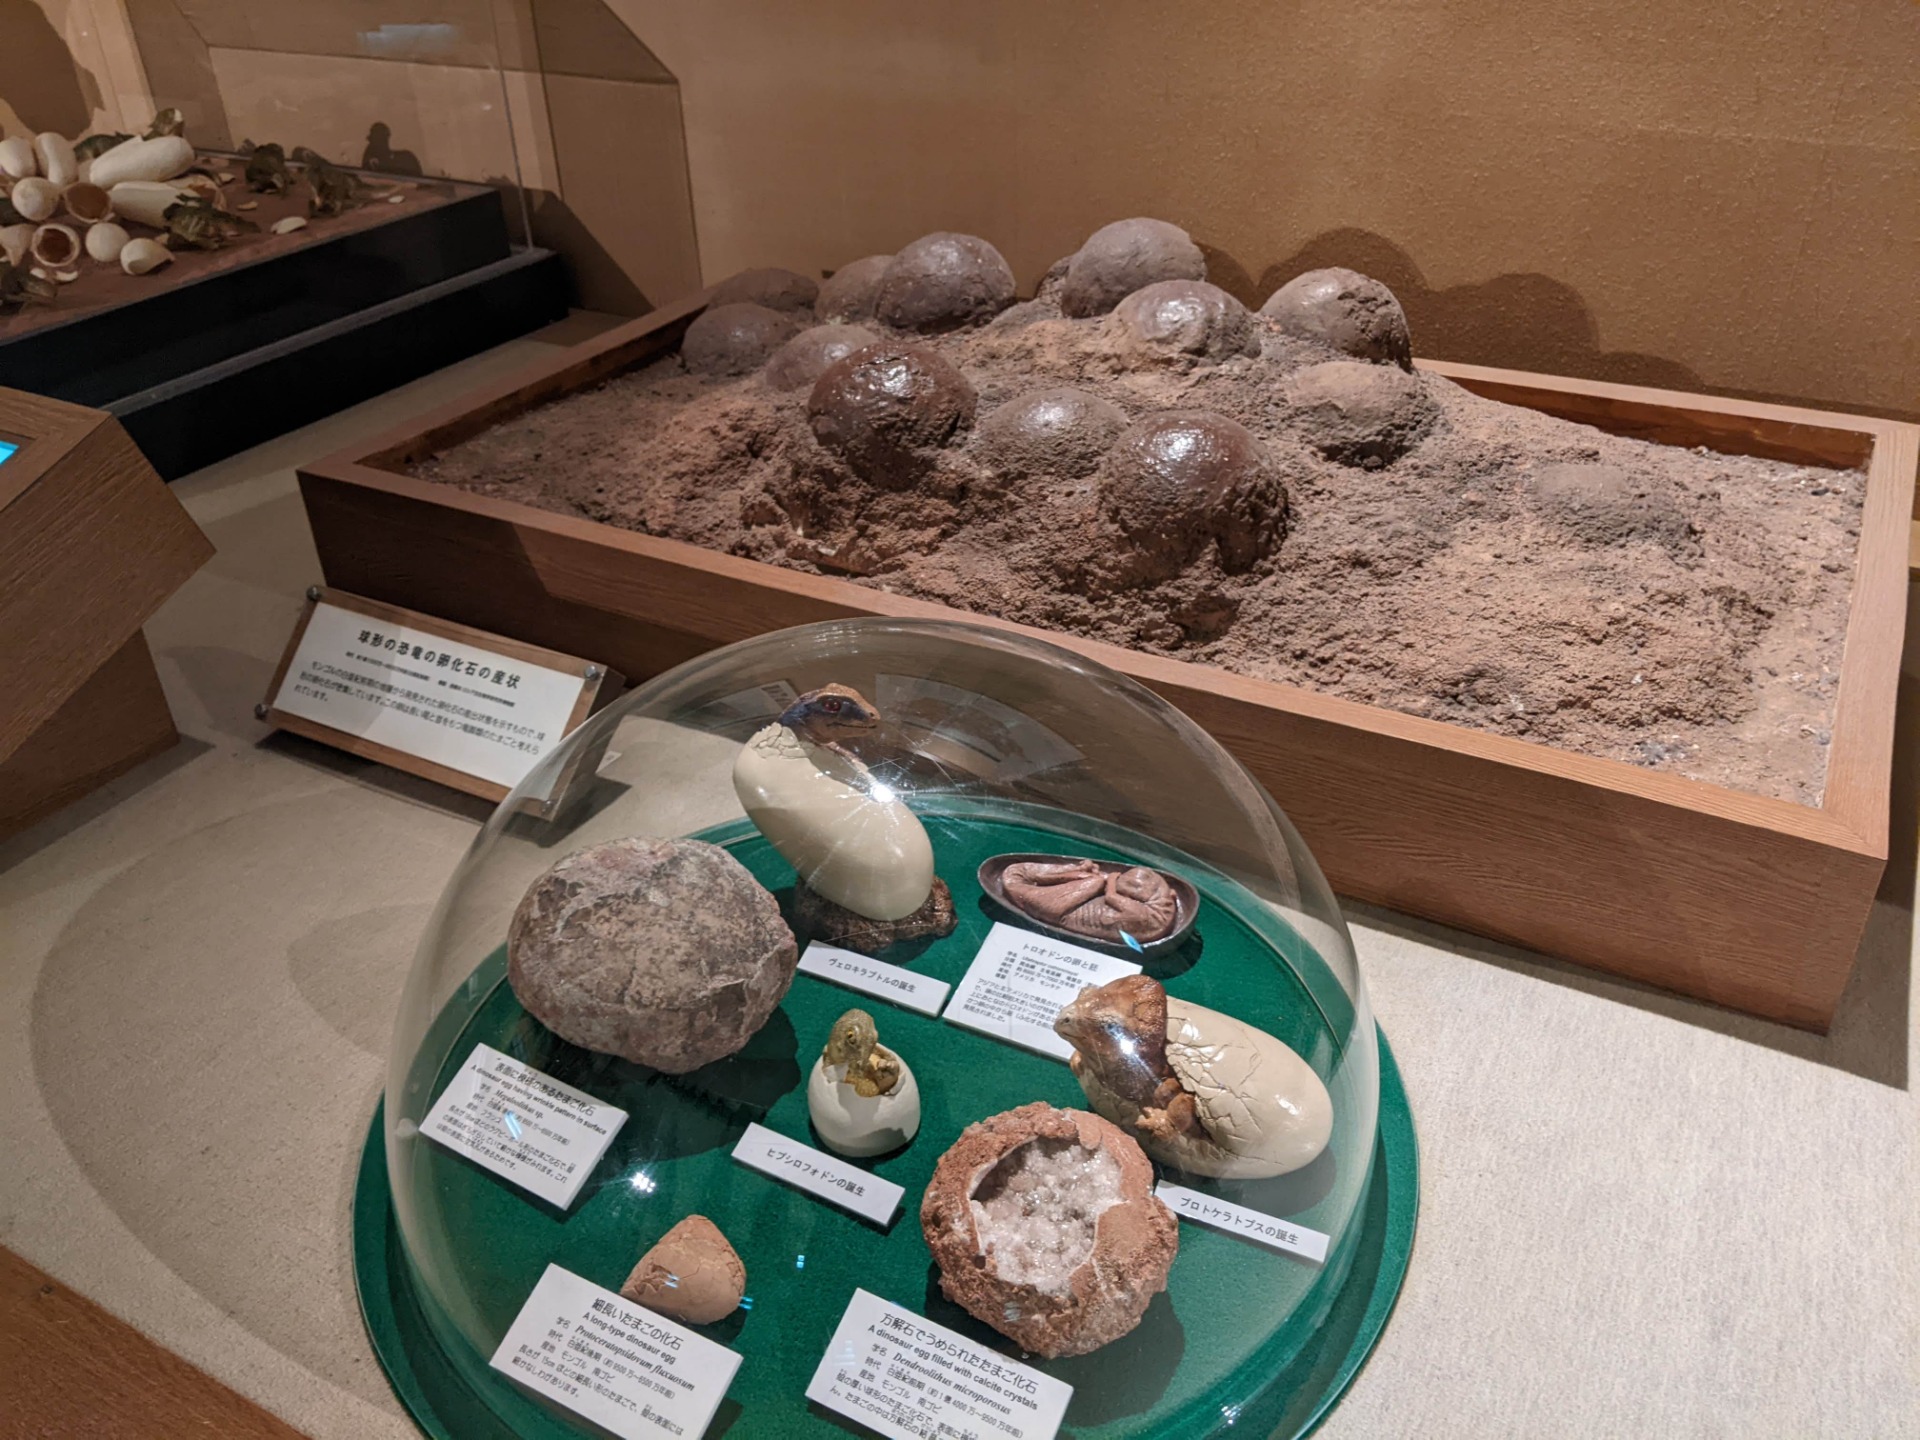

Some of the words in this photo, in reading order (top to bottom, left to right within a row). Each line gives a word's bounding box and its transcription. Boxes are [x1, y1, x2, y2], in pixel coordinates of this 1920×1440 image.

[357, 629, 521, 689] 球形の恐竜の卵化石の産状
[828, 957, 916, 993] ヴェロキラプトルの誕生
[1022, 943, 1099, 972] トロオドンの卵と胚
[475, 1067, 502, 1083] dinosaur
[500, 1080, 513, 1090] egg
[512, 1084, 533, 1100] having
[532, 1095, 555, 1109] wrinkle
[553, 1106, 576, 1121] pattern
[575, 1116, 584, 1124] in
[582, 1120, 607, 1135] surface
[766, 1147, 866, 1197] ヒプシロフォドンの誕生
[1180, 1197, 1299, 1245] プロトケラトプスの誕生
[582, 1311, 591, 1320] A
[589, 1315, 626, 1339] long-type
[625, 1333, 660, 1355] dinosaur
[659, 1351, 676, 1365] egg
[591, 1297, 684, 1351] 細長いたまごの化石
[561, 1350, 588, 1369] モンゴル
[591, 1366, 615, 1384] 南ゴビ
[867, 1324, 876, 1333] A
[875, 1328, 913, 1351] dinosaur
[913, 1346, 930, 1360] egg
[930, 1353, 953, 1369] filled
[953, 1365, 973, 1379] with
[973, 1374, 1003, 1393] calcite
[1003, 1389, 1038, 1411] crystals
[879, 1312, 1038, 1395] 方解石でうめられたたまご化石
[858, 1368, 875, 1382] 産地
[881, 1379, 911, 1400] モンゴル
[916, 1396, 942, 1415] 南ゴビ
[892, 1352, 953, 1387] Dendroolithus
[952, 1382, 1011, 1416] microporosus
